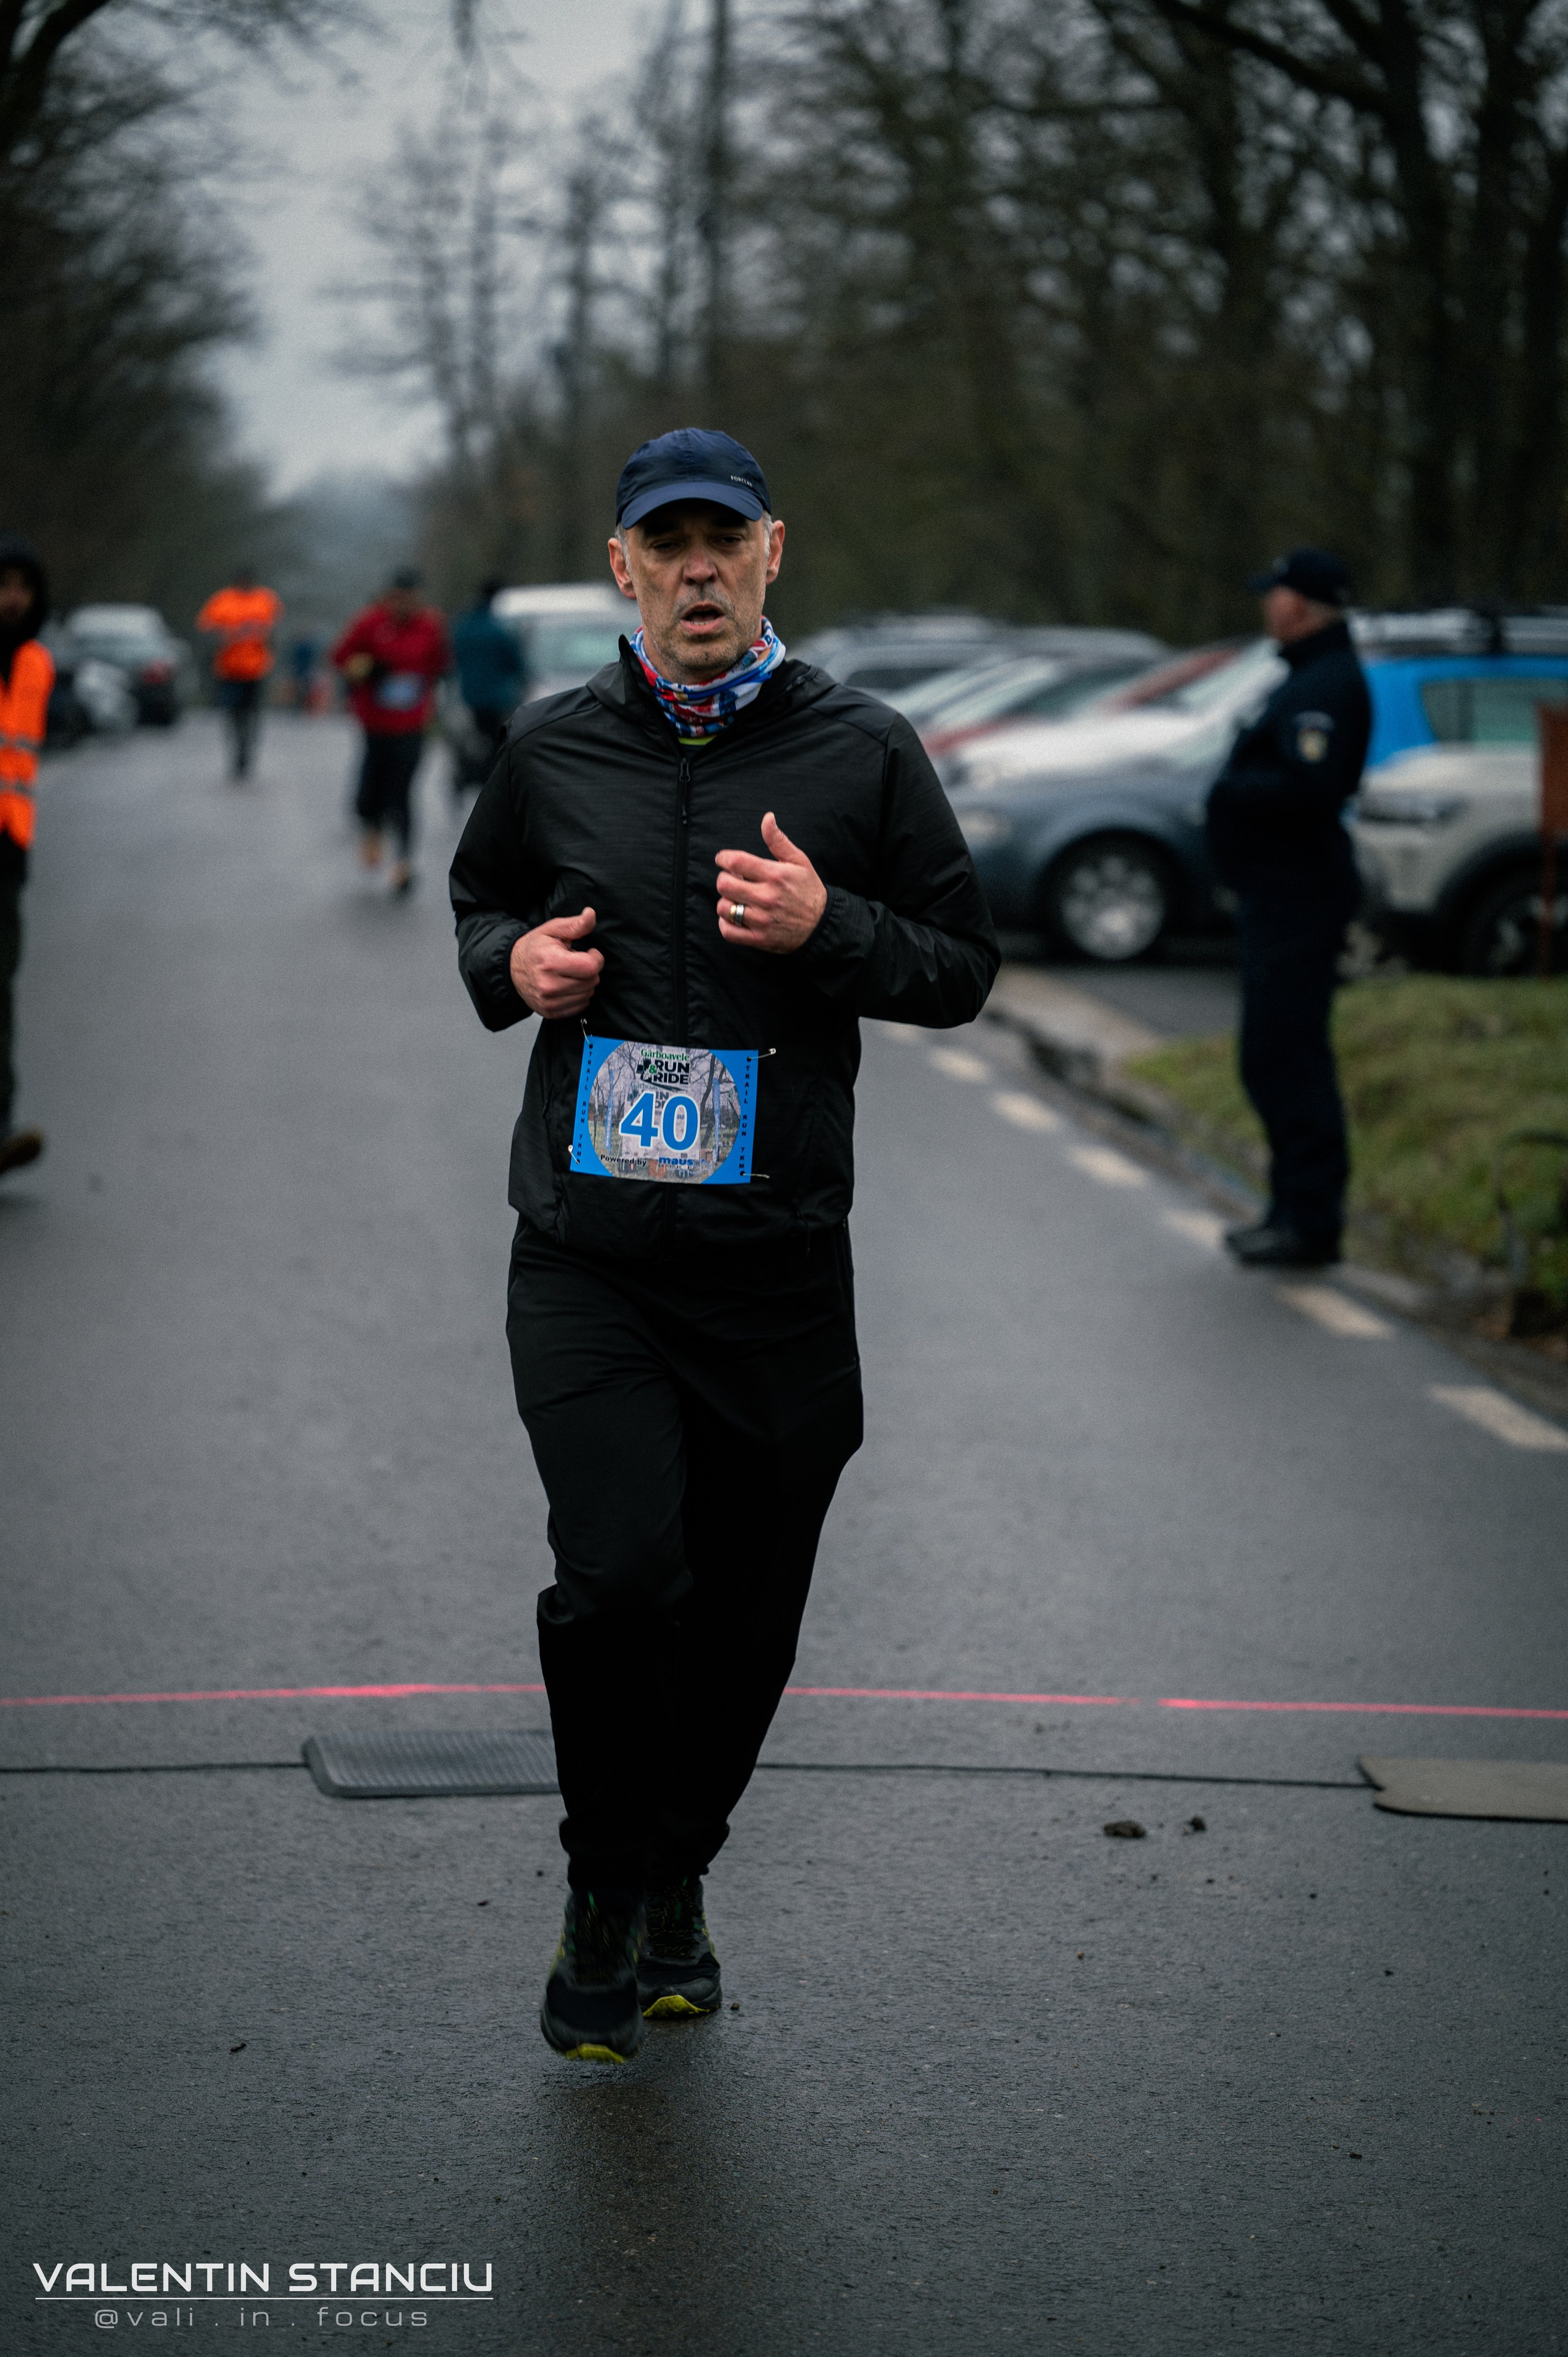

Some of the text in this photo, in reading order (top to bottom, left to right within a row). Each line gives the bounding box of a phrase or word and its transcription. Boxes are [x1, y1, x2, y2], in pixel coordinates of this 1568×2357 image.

[655, 1060, 690, 1073] RUN
[654, 1073, 689, 1085] RIDE
[619, 1092, 699, 1152] 40
[600, 1154, 647, 1167] Powered by
[658, 1156, 693, 1166] maus
